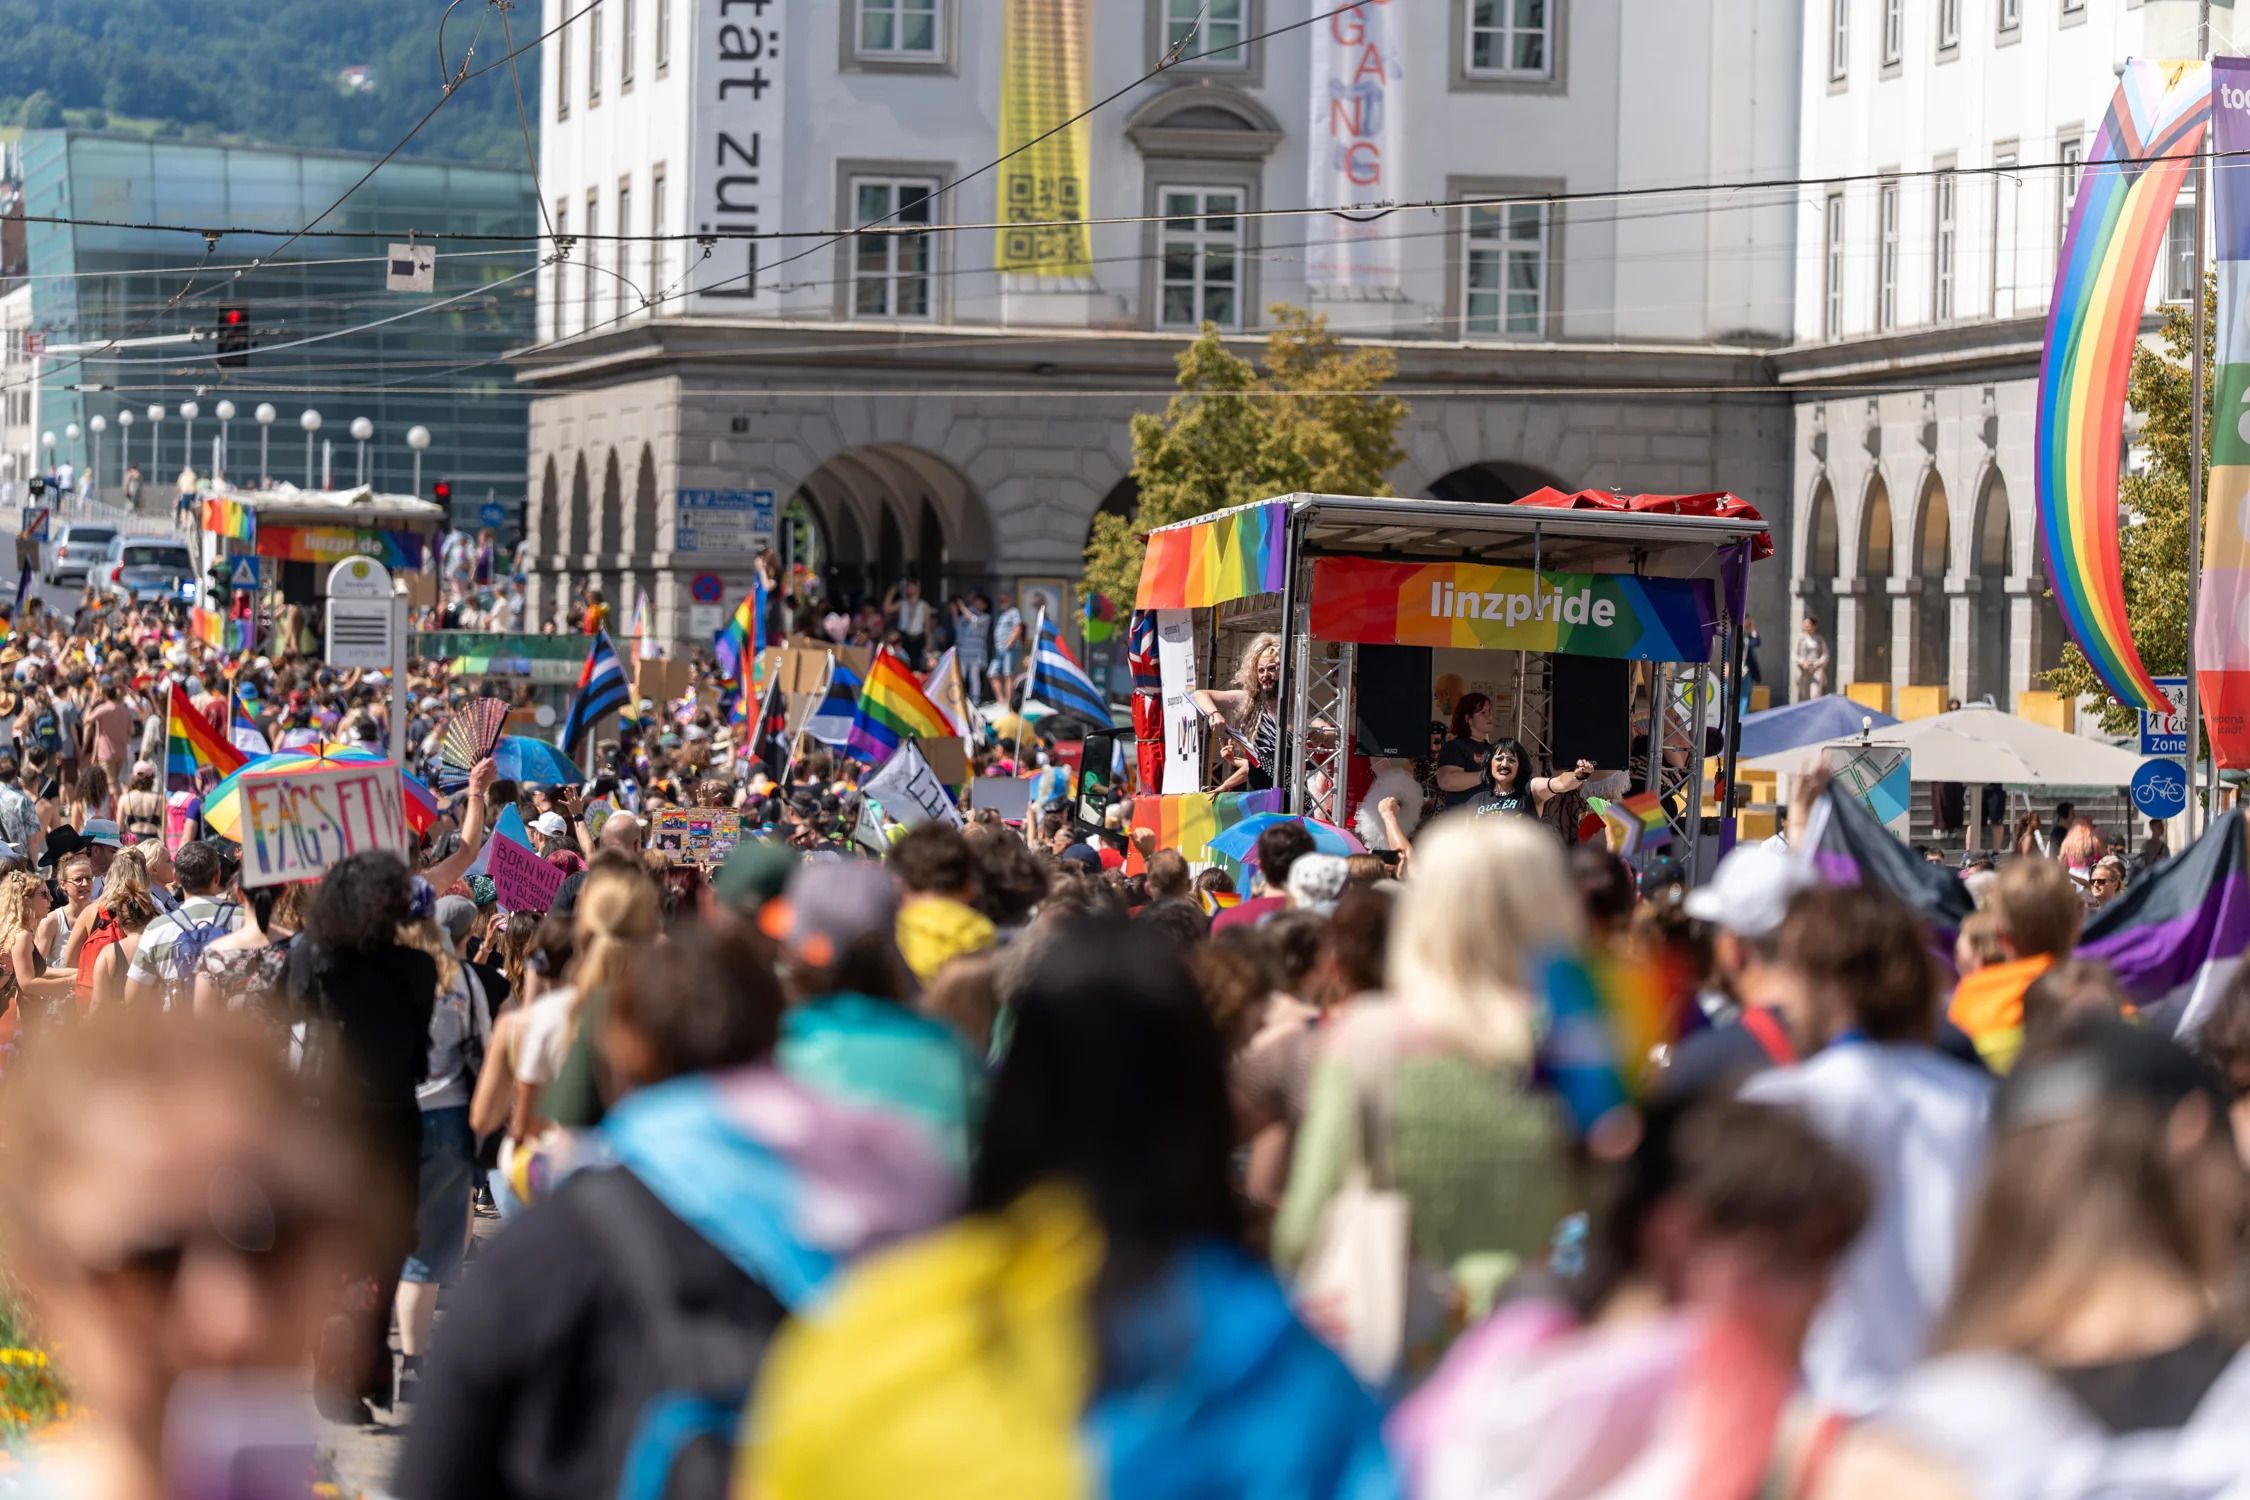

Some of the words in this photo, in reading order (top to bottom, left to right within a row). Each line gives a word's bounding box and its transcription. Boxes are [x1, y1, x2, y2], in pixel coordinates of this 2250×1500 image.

[1430, 581, 1616, 628] linzpride
[2151, 738, 2186, 751] Zone
[497, 842, 535, 876] BORN
